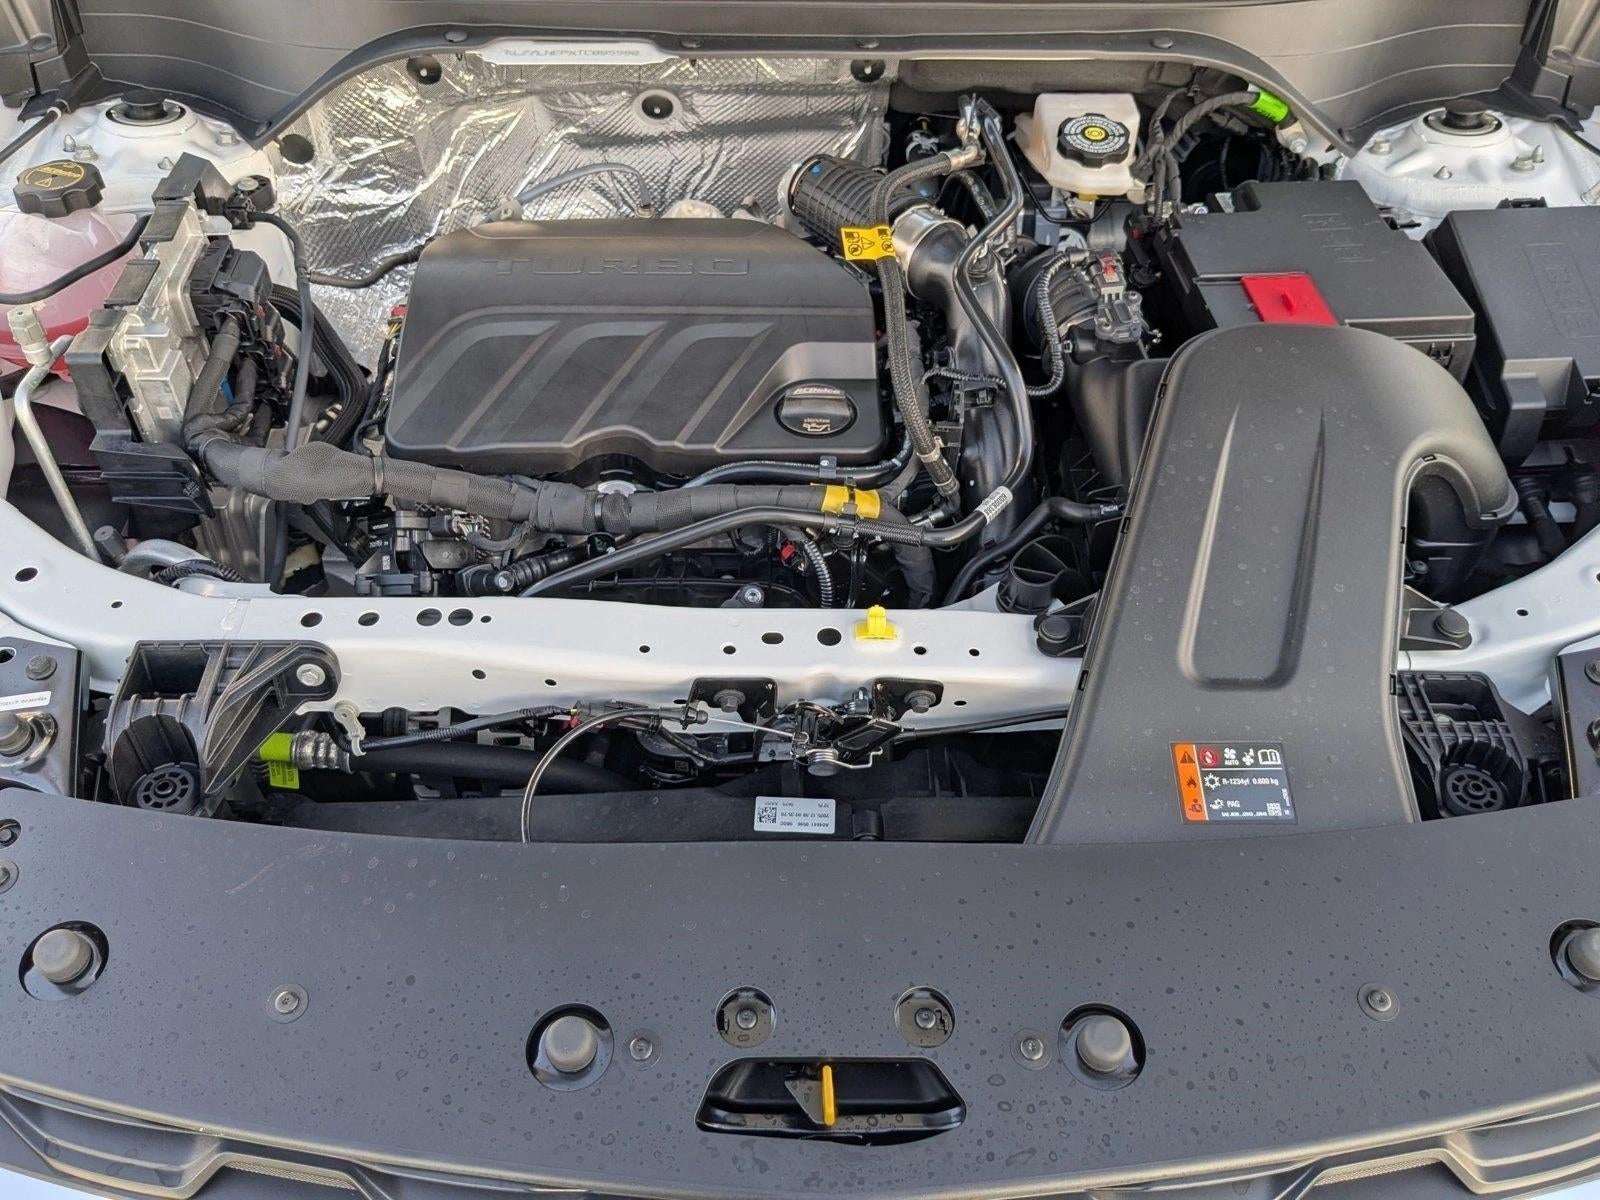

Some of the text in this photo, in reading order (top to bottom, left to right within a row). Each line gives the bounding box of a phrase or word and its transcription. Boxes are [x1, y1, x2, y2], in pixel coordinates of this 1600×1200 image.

[480, 257, 750, 276] TURBO
[793, 387, 840, 396] ACDelco
[1270, 777, 1279, 786] kg
[1227, 800, 1240, 808] PAG
